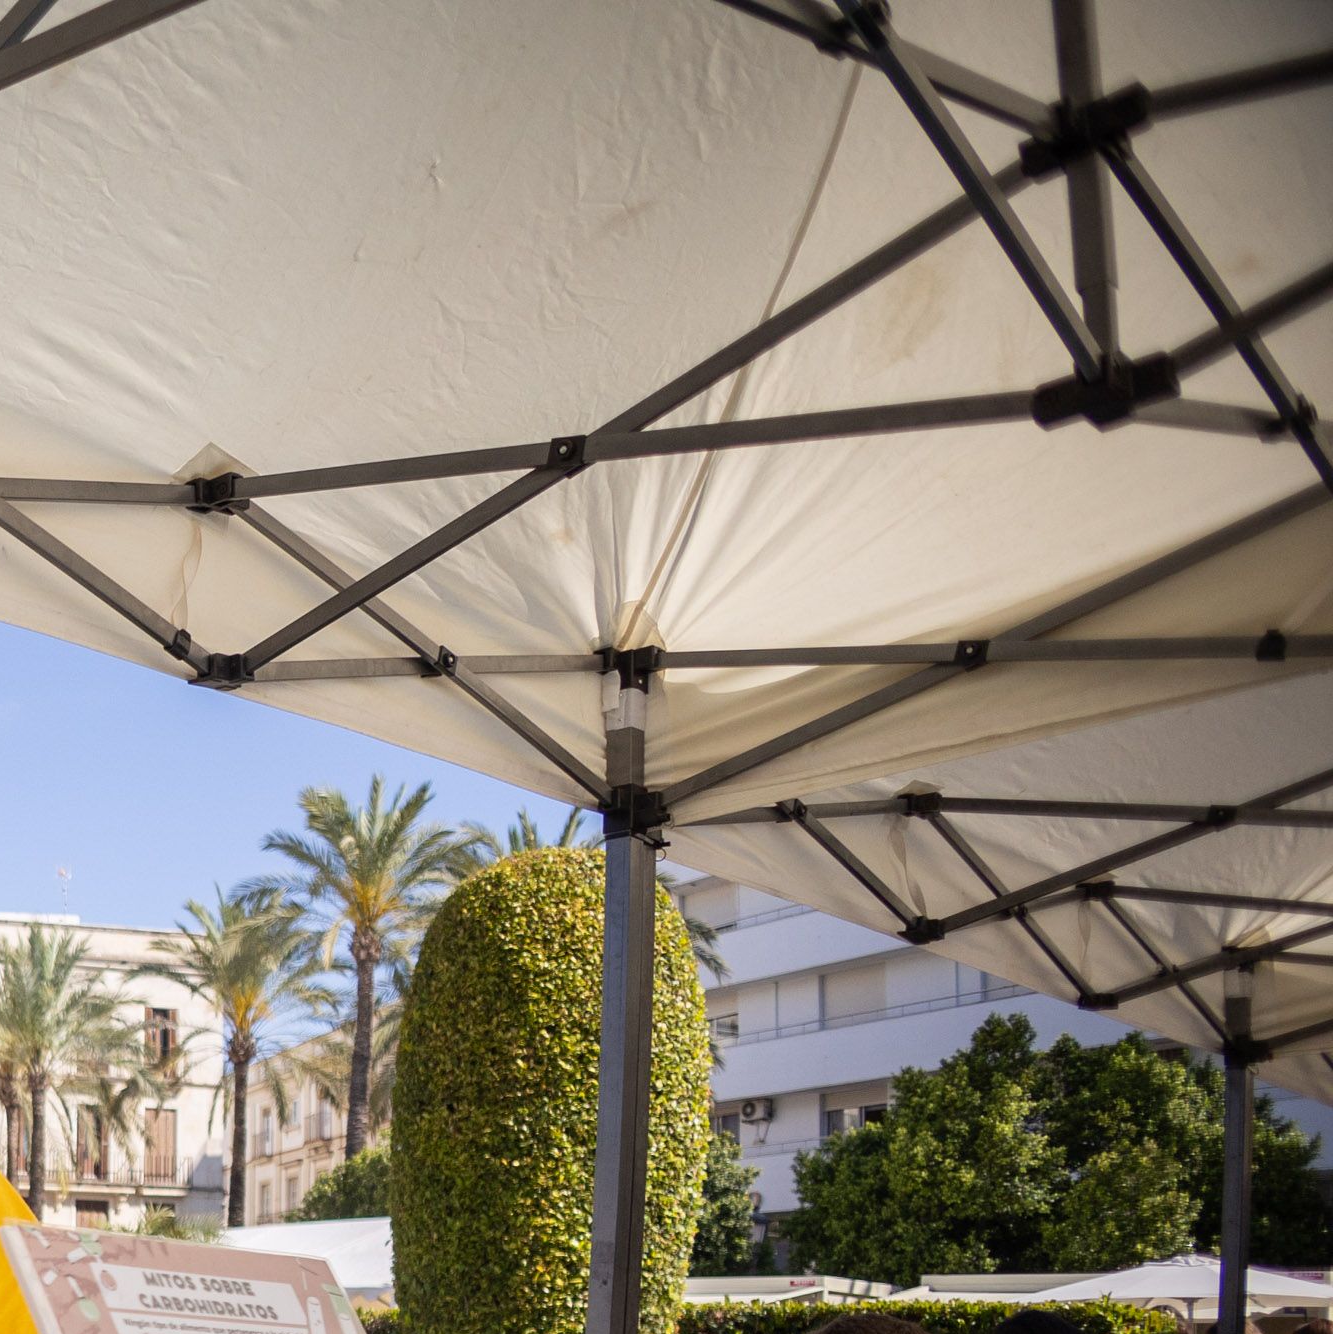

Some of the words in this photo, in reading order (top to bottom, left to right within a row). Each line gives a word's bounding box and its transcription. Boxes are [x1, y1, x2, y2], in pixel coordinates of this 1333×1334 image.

[142, 1271, 198, 1291] MITOS
[199, 1277, 256, 1297] SOBRE
[138, 1293, 279, 1321] CARBOHIDRATOS
